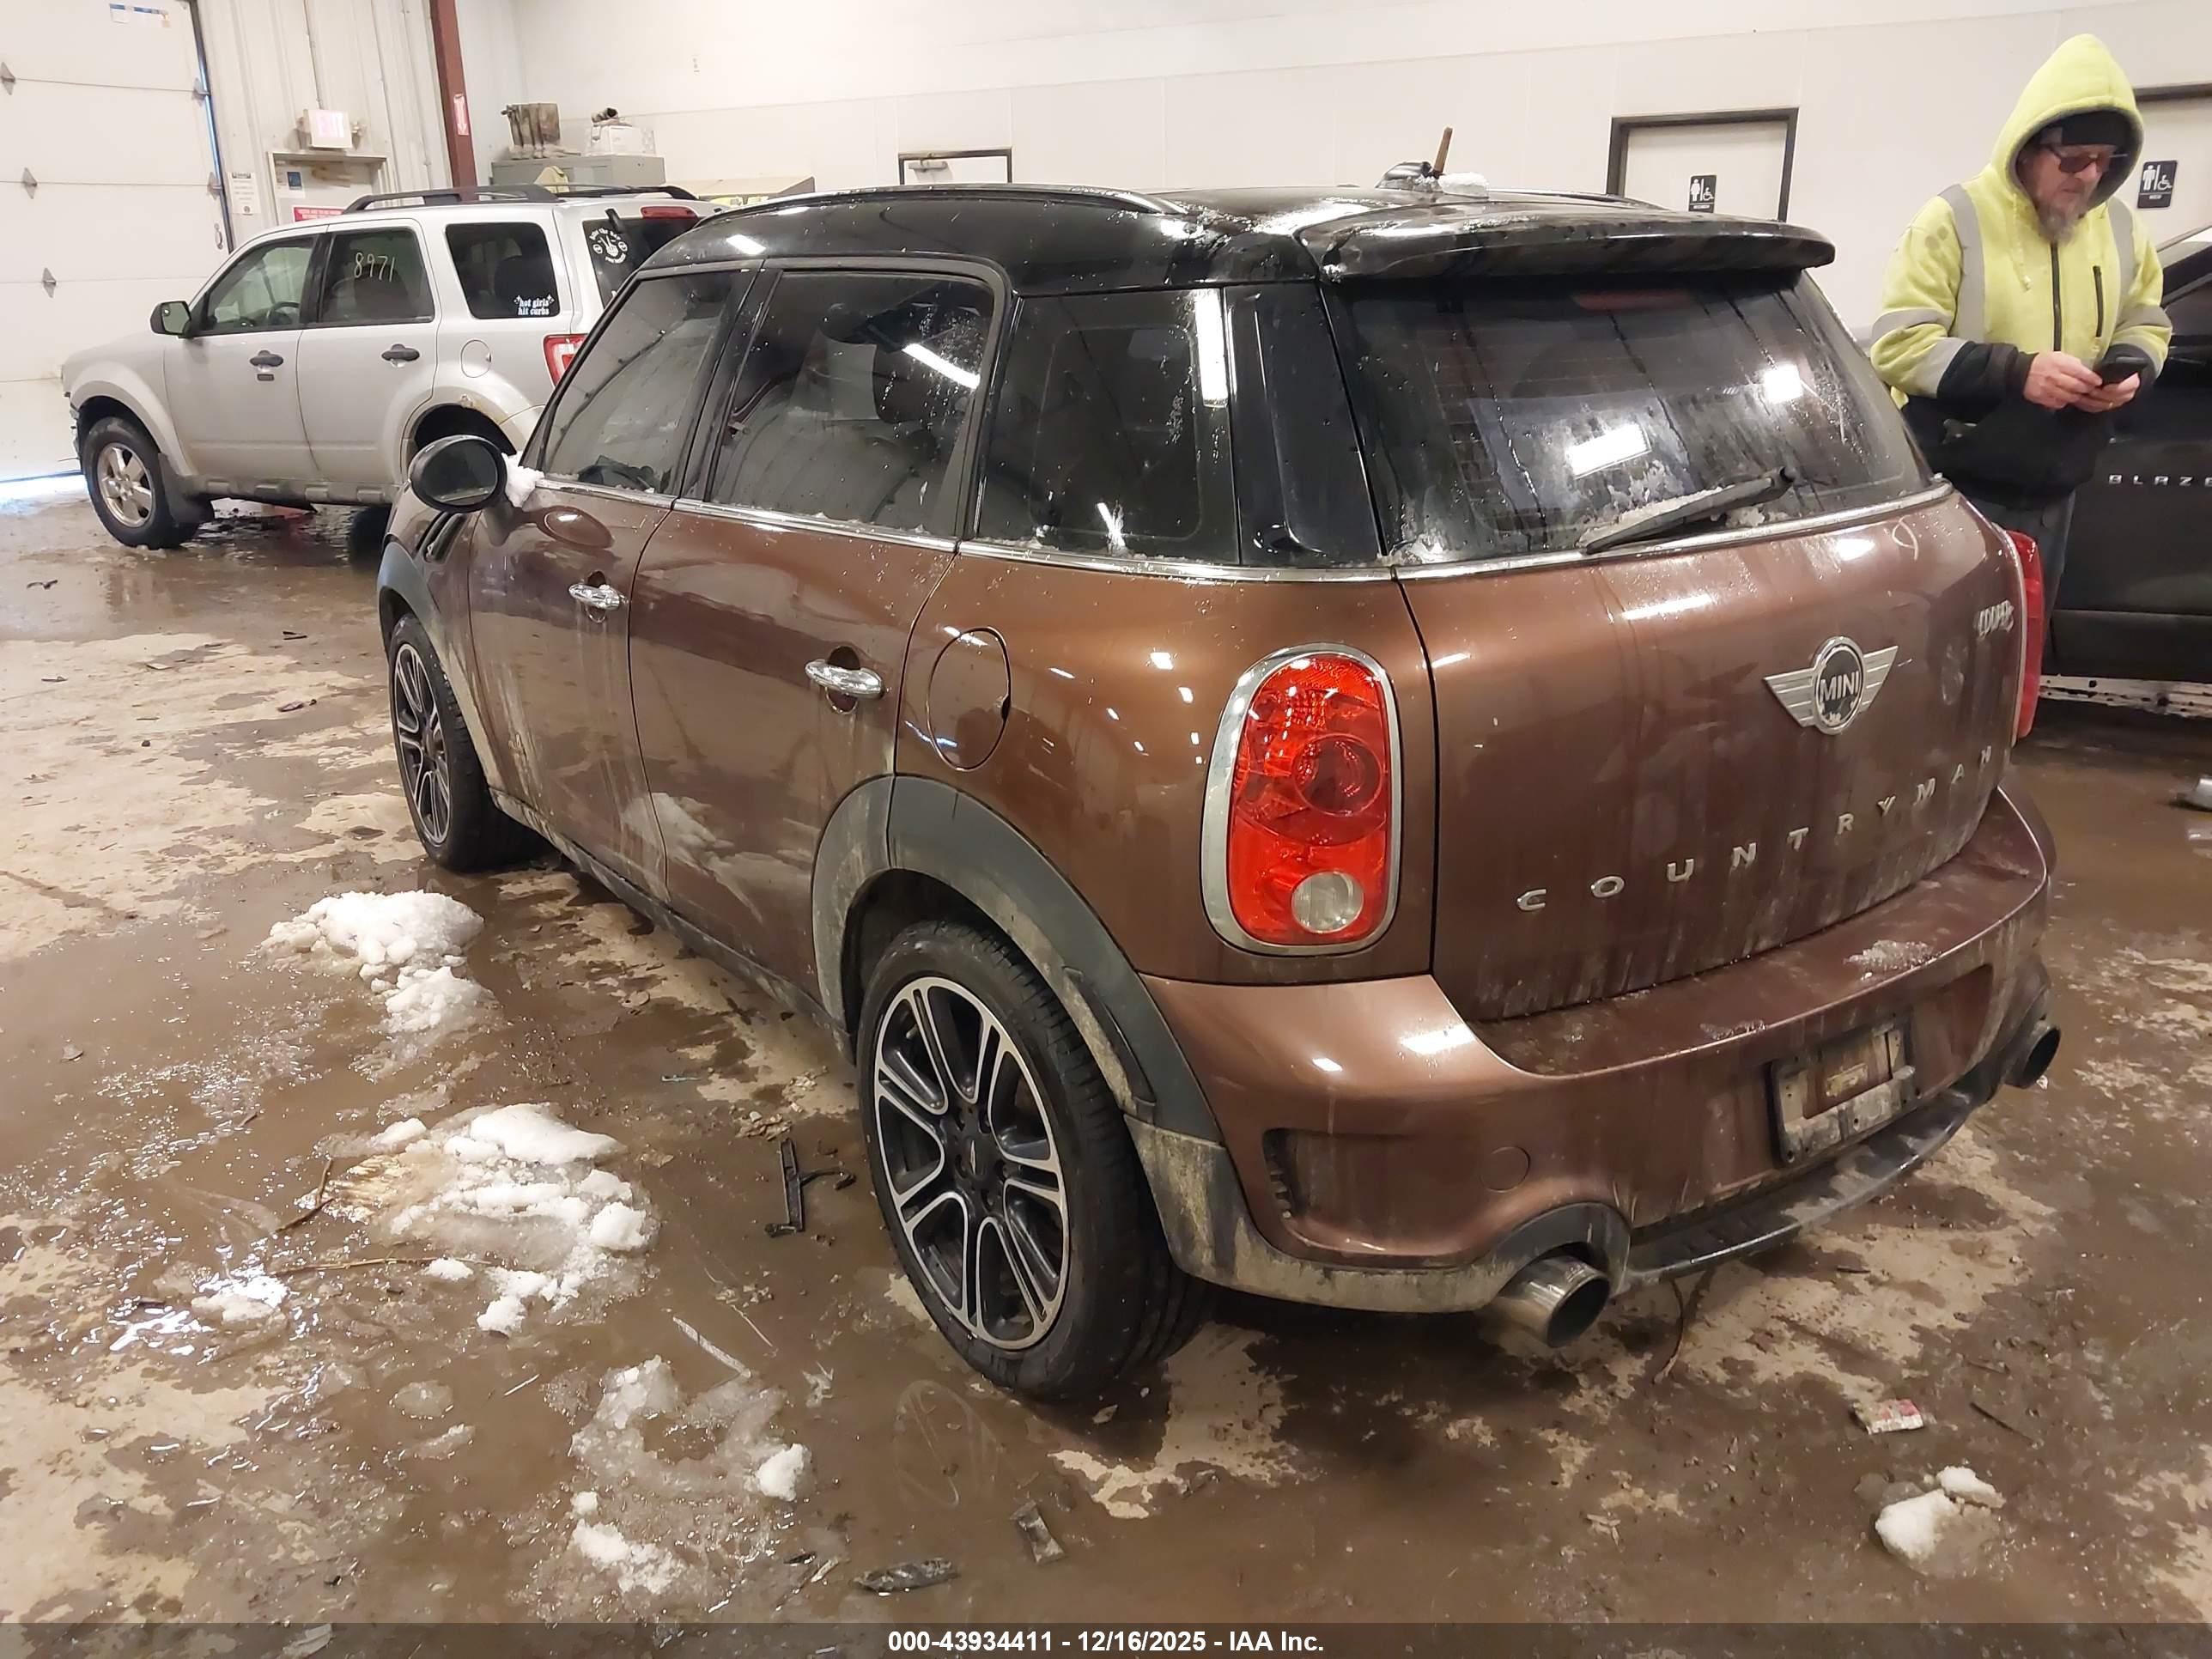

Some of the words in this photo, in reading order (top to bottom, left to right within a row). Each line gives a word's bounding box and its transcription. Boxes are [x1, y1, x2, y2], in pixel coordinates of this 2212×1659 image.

[354, 252, 395, 283] 8971
[517, 307, 529, 316] hit
[530, 307, 550, 316] curbs
[519, 297, 532, 307] hot
[532, 297, 550, 309] girls
[1820, 671, 1859, 702] MINI
[1516, 745, 1992, 911] COUNTRYMAN
